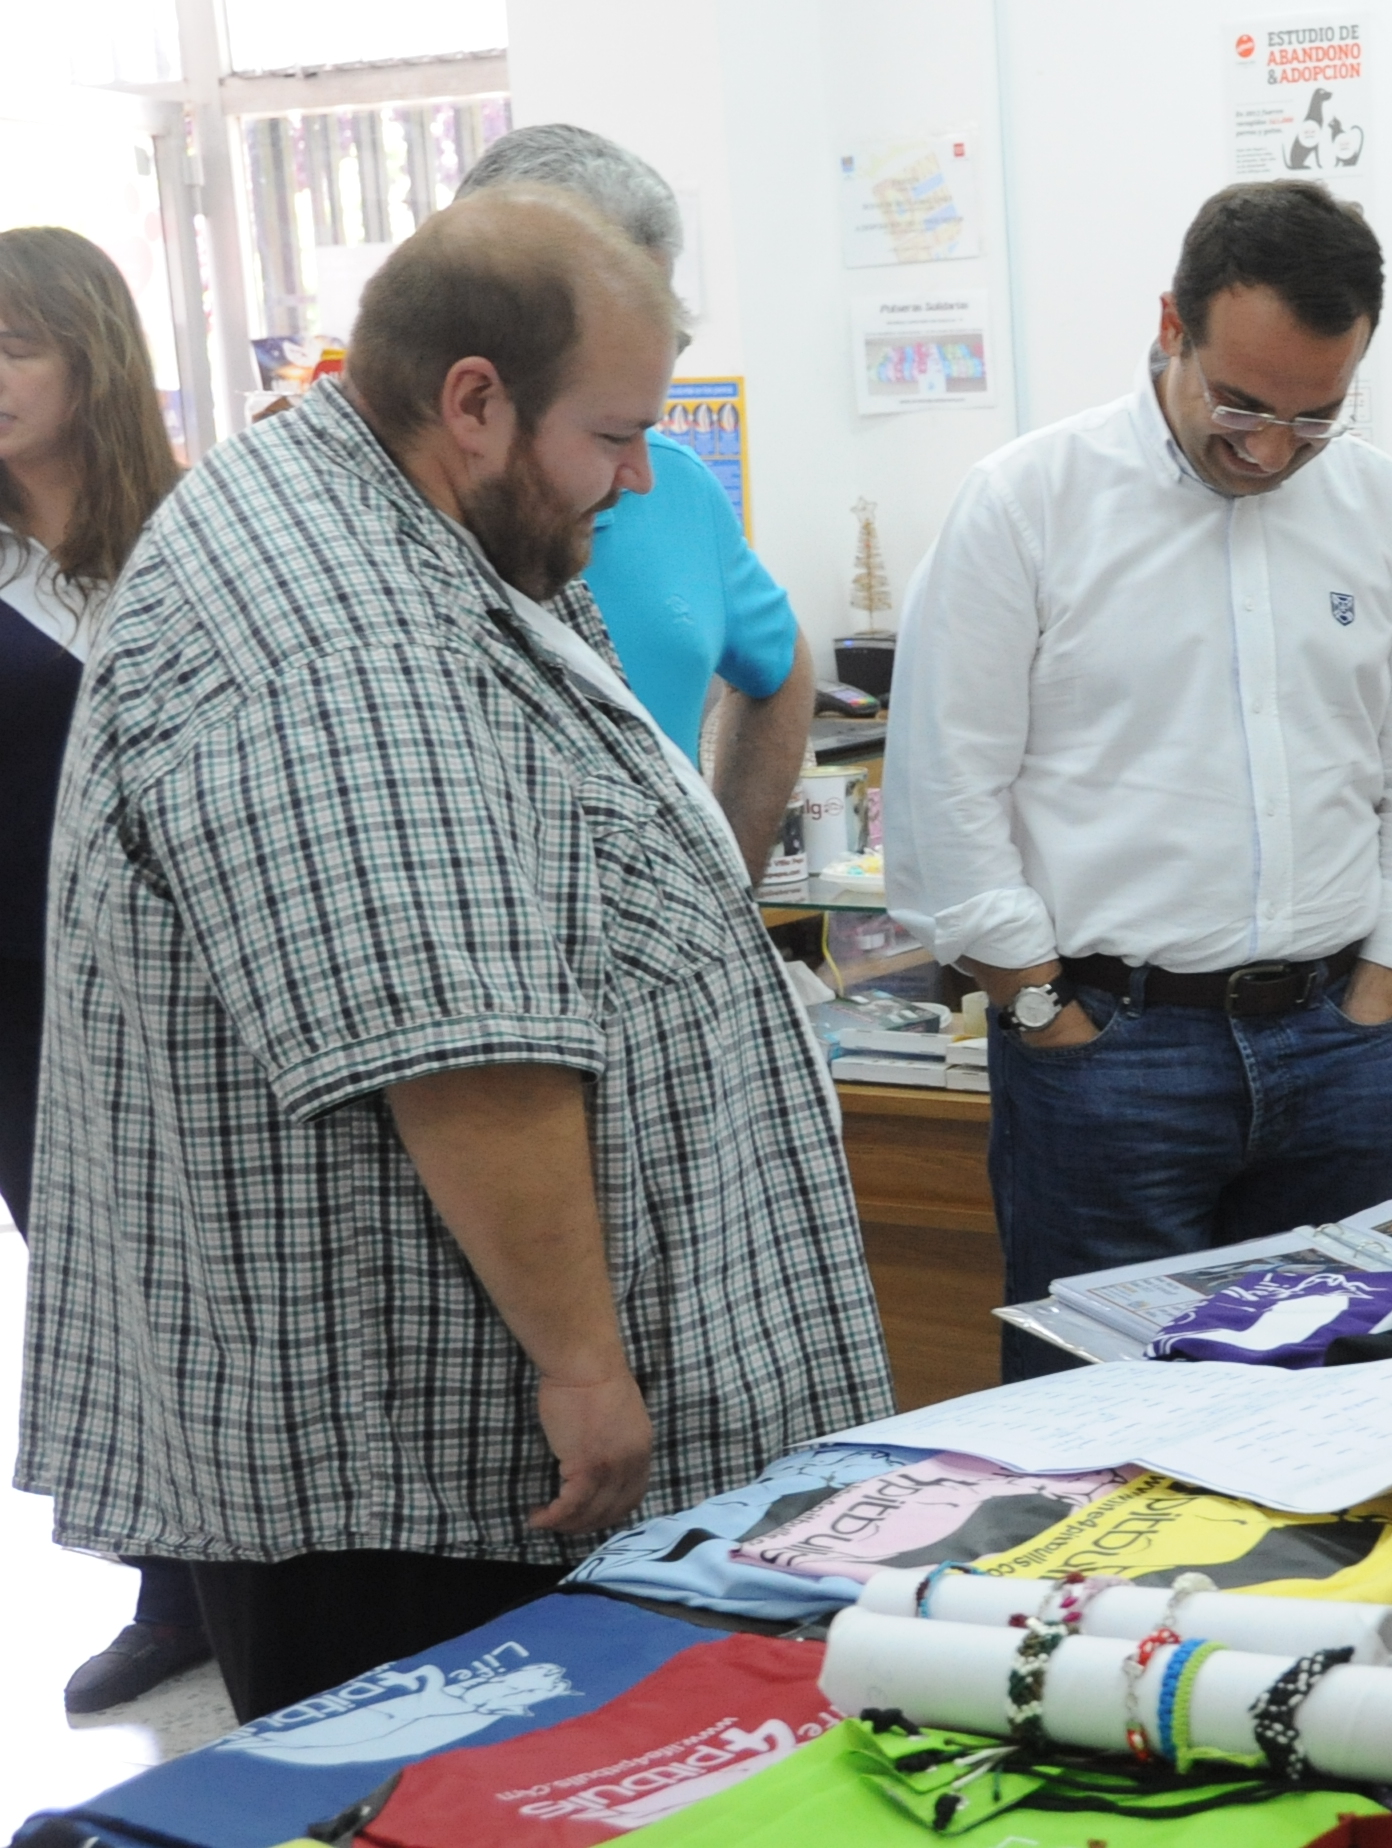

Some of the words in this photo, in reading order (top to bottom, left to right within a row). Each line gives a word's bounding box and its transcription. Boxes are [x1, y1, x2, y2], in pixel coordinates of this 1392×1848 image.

[1267, 26, 1335, 47] ESTUDIO
[1338, 24, 1360, 42] DE
[1266, 43, 1362, 67] ABANDONO
[448, 1640, 530, 1682] Life
[518, 1718, 797, 1819] 4pitbulls
